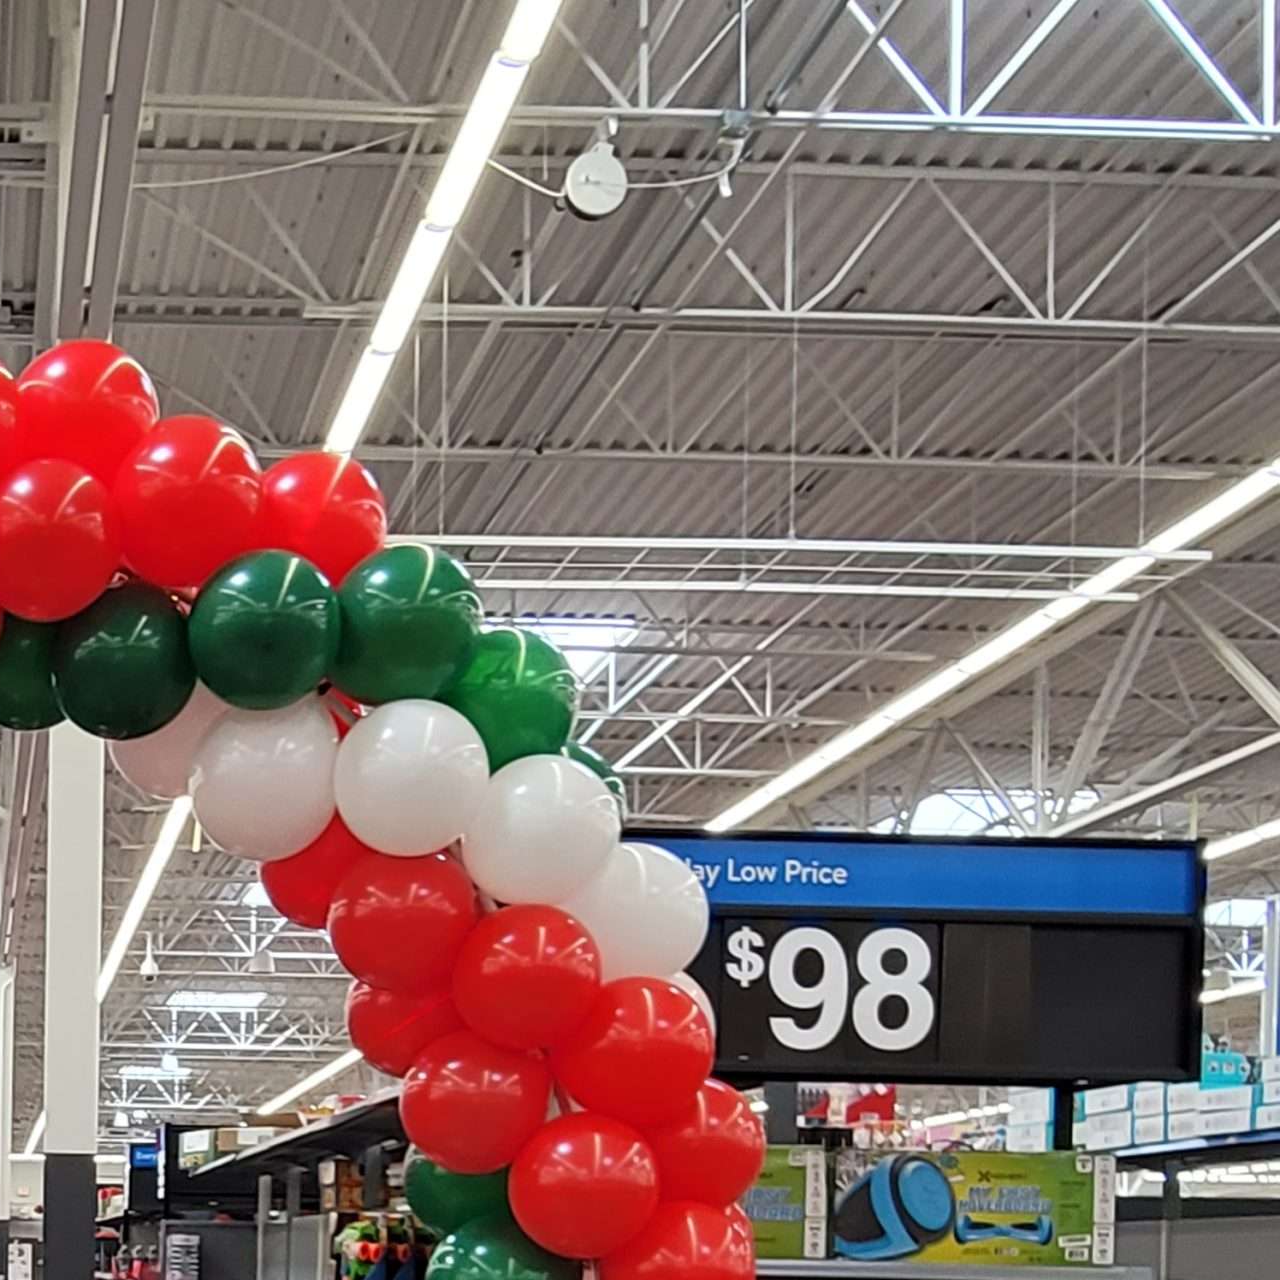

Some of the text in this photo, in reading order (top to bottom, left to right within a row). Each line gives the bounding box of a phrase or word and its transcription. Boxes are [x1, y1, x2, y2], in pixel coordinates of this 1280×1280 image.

[727, 859, 778, 883] Low
[784, 859, 849, 885] Price
[725, 926, 935, 1051] $98
